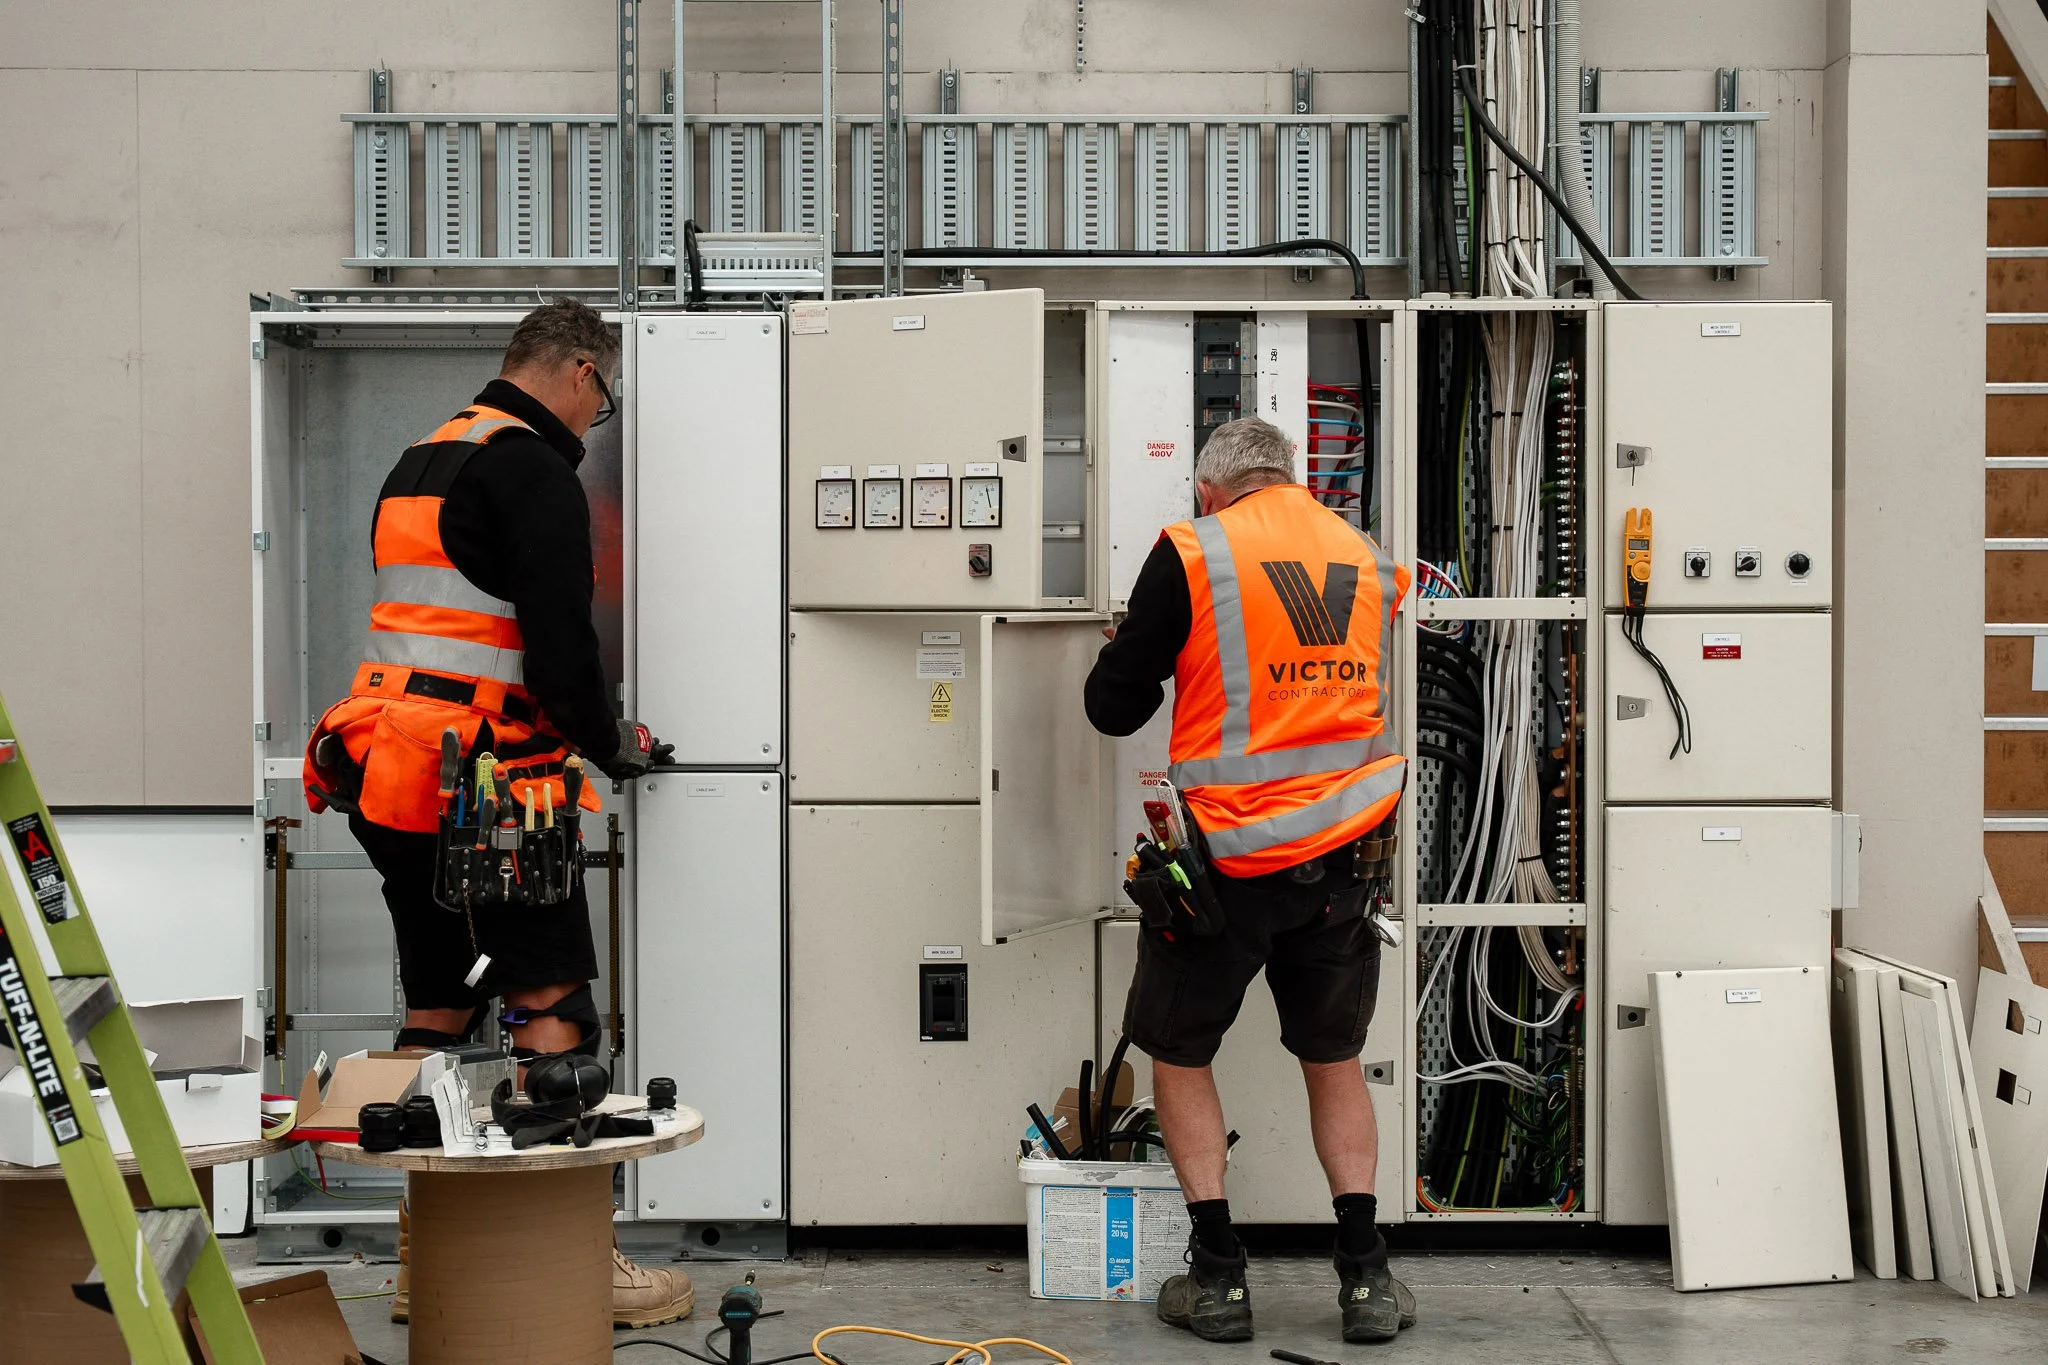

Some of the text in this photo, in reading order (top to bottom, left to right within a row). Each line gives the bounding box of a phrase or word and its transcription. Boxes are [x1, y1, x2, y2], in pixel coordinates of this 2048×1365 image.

[1147, 442, 1175, 450] DANGER
[1149, 450, 1173, 458] 400V
[1268, 660, 1367, 683] VICTOR
[1268, 686, 1366, 701] CONTRACTORS
[1139, 771, 1167, 779] DANGER
[36, 874, 57, 889] 150
[0, 957, 62, 1097] TUFF-N-LITE
[1111, 1229, 1129, 1239] 20 kg
